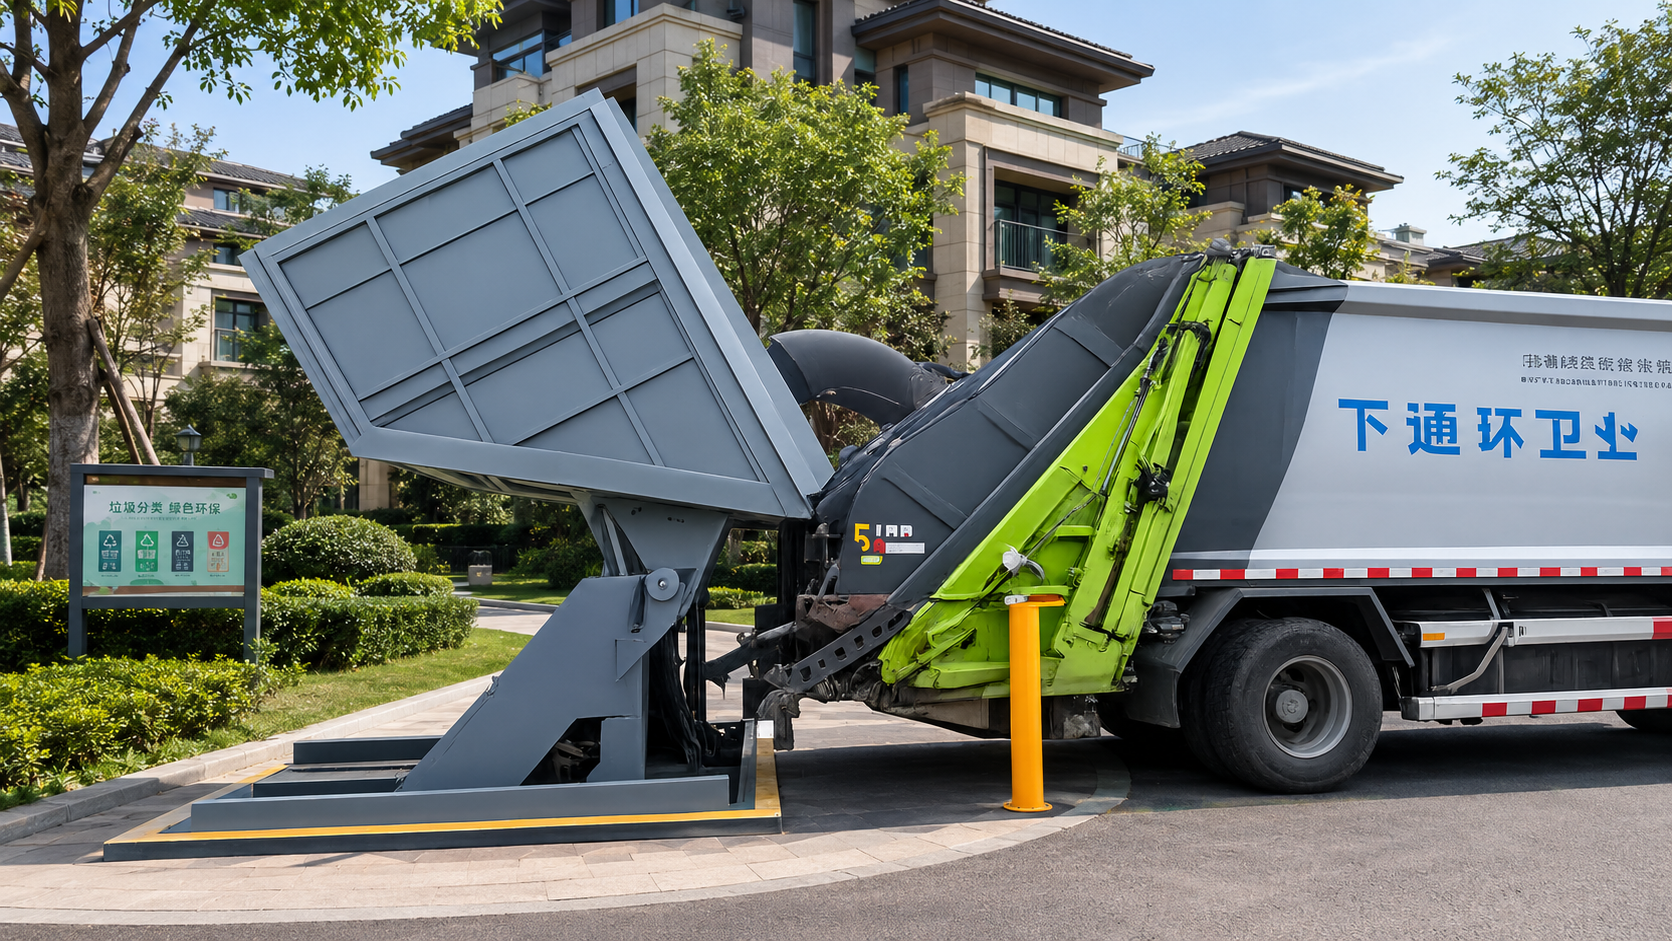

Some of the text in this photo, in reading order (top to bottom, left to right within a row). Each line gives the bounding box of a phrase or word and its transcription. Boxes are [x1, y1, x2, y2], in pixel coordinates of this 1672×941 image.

[109, 501, 221, 515] 垃圾分类 绿色环保
[854, 523, 871, 552] 5
